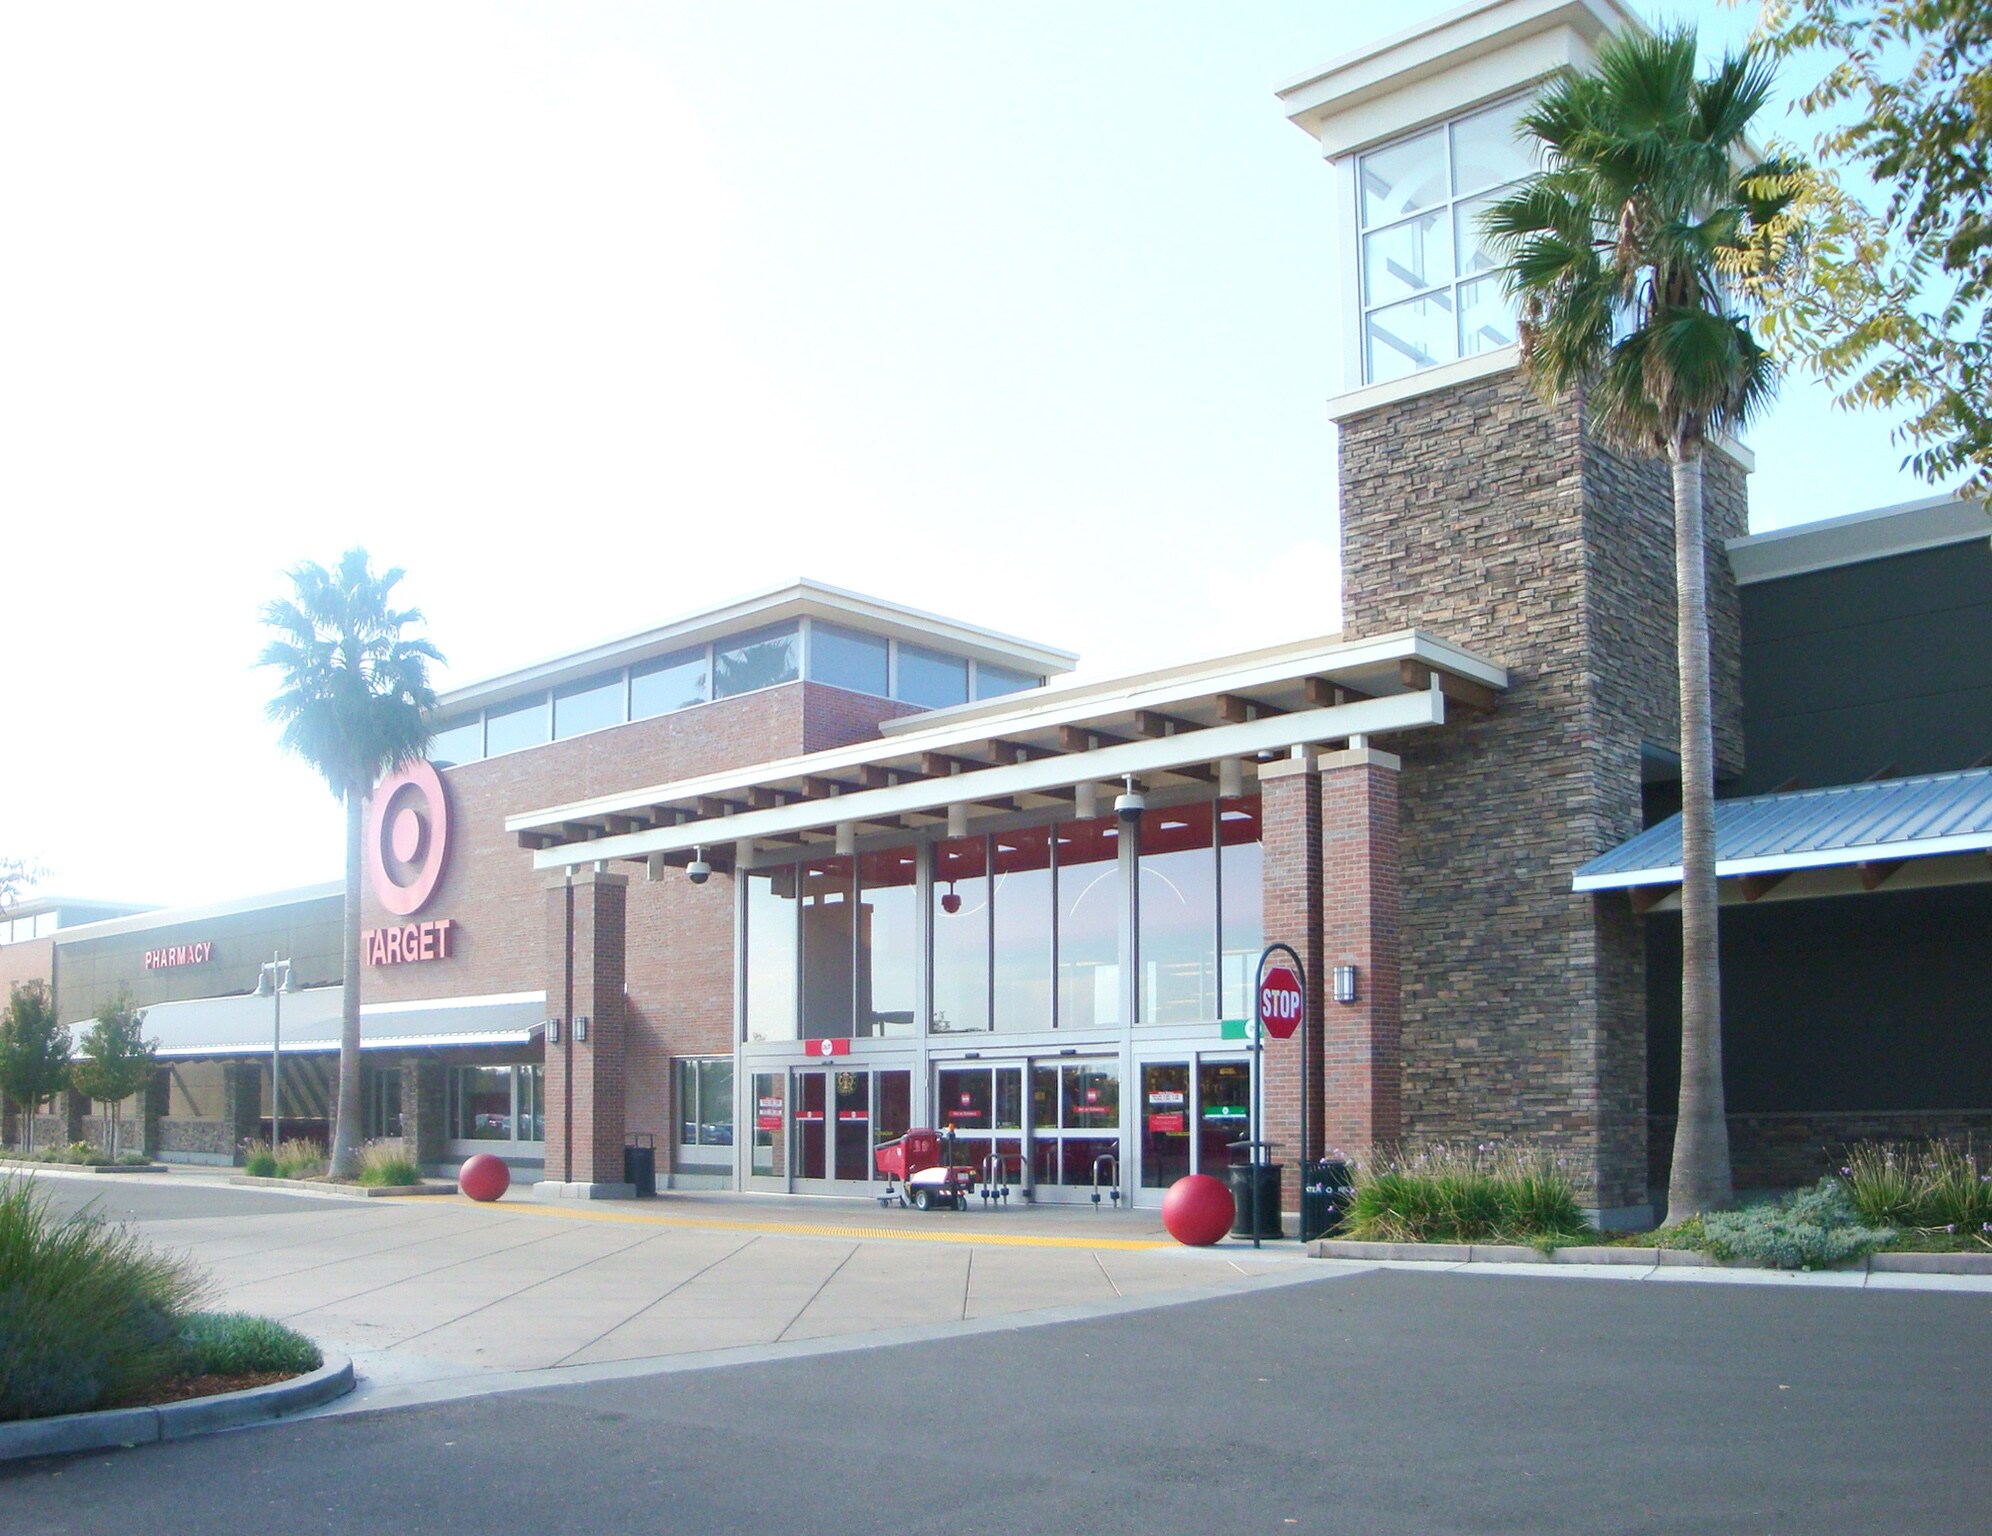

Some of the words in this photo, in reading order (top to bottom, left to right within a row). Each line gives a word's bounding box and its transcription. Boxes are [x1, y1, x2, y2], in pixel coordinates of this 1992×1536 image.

[145, 942, 211, 969] PHARMACY
[361, 919, 450, 966] TARGET
[1262, 988, 1300, 1018] STOP
